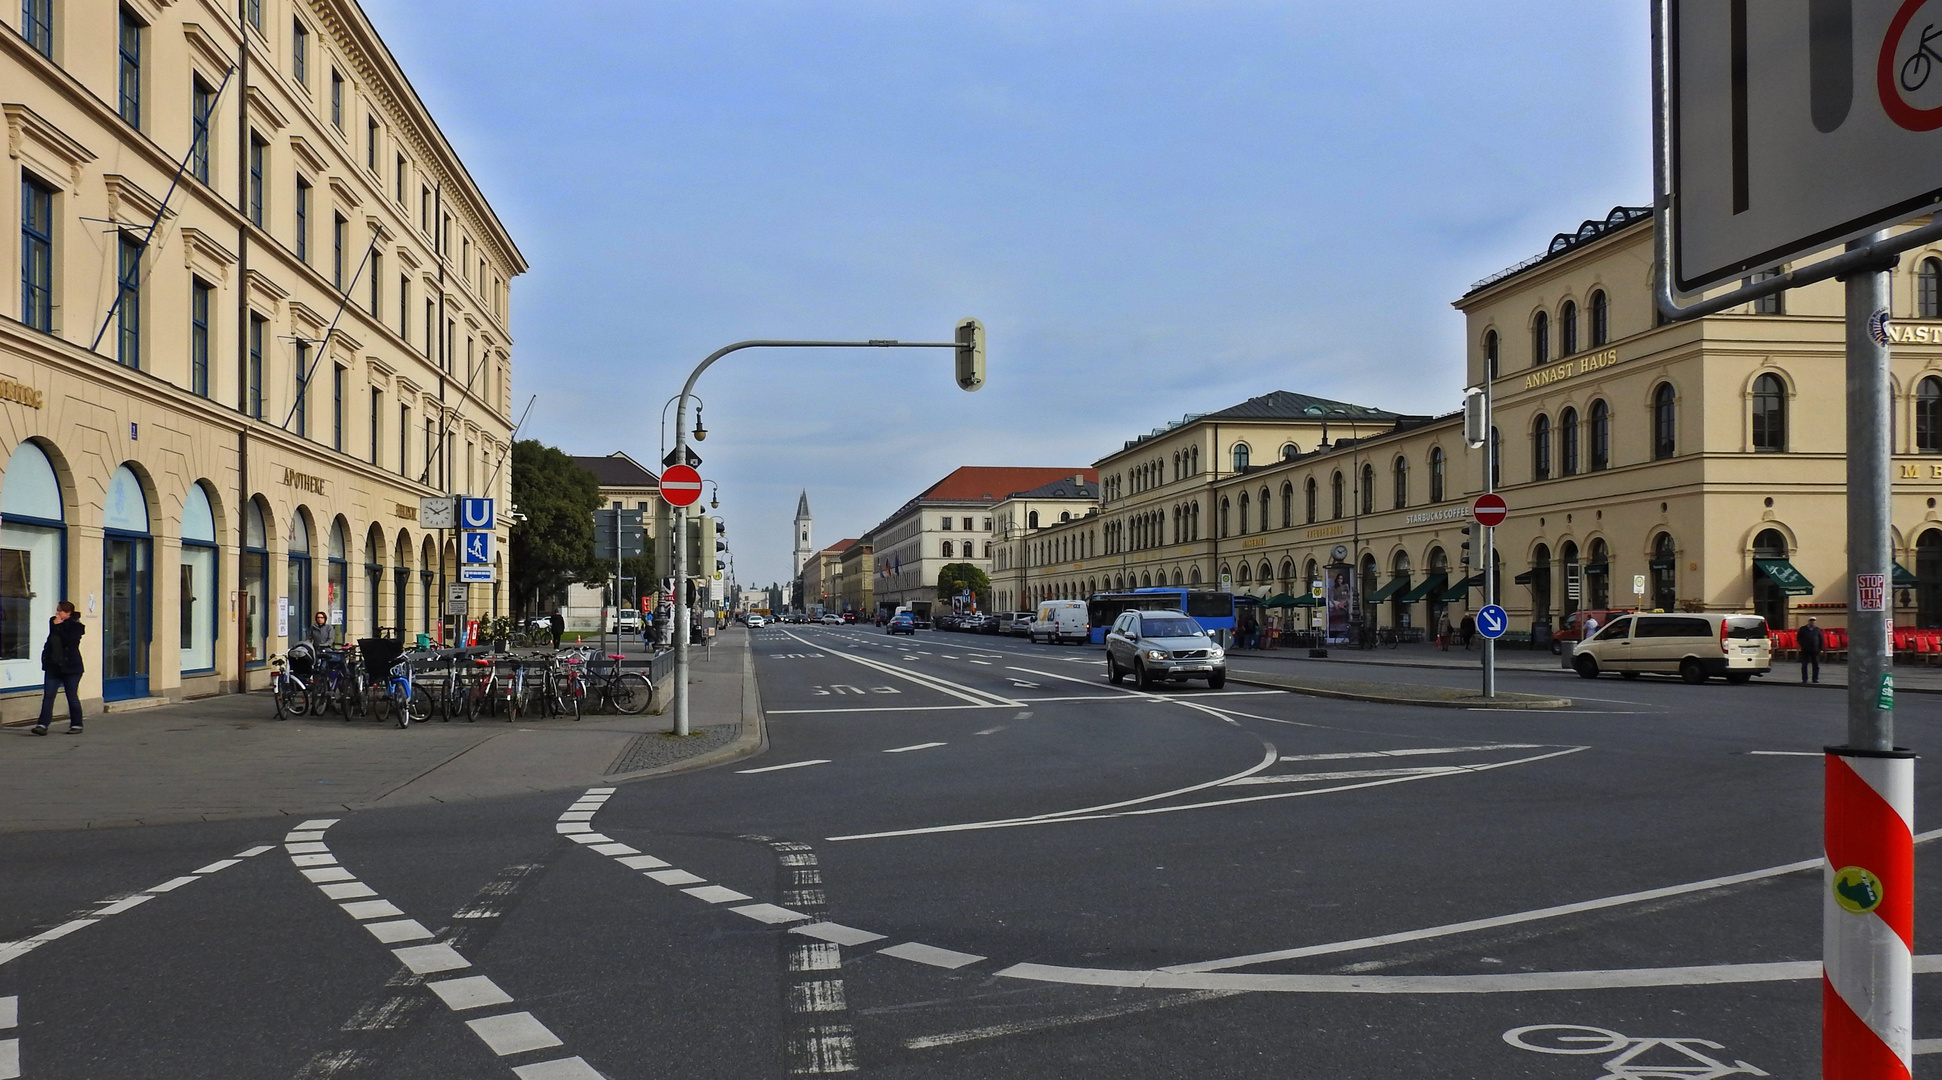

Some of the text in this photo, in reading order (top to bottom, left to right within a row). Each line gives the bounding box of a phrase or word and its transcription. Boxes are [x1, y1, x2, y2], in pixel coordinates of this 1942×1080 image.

[1525, 350, 1617, 389] ANNAST HAUS
[283, 467, 326, 496] APOTHEKE
[466, 499, 490, 527] U
[1406, 507, 1469, 524] STARBUCKS COFFEE
[1860, 575, 1883, 588] STOP
[1860, 587, 1882, 599] TTIP
[1862, 599, 1881, 609] CETA
